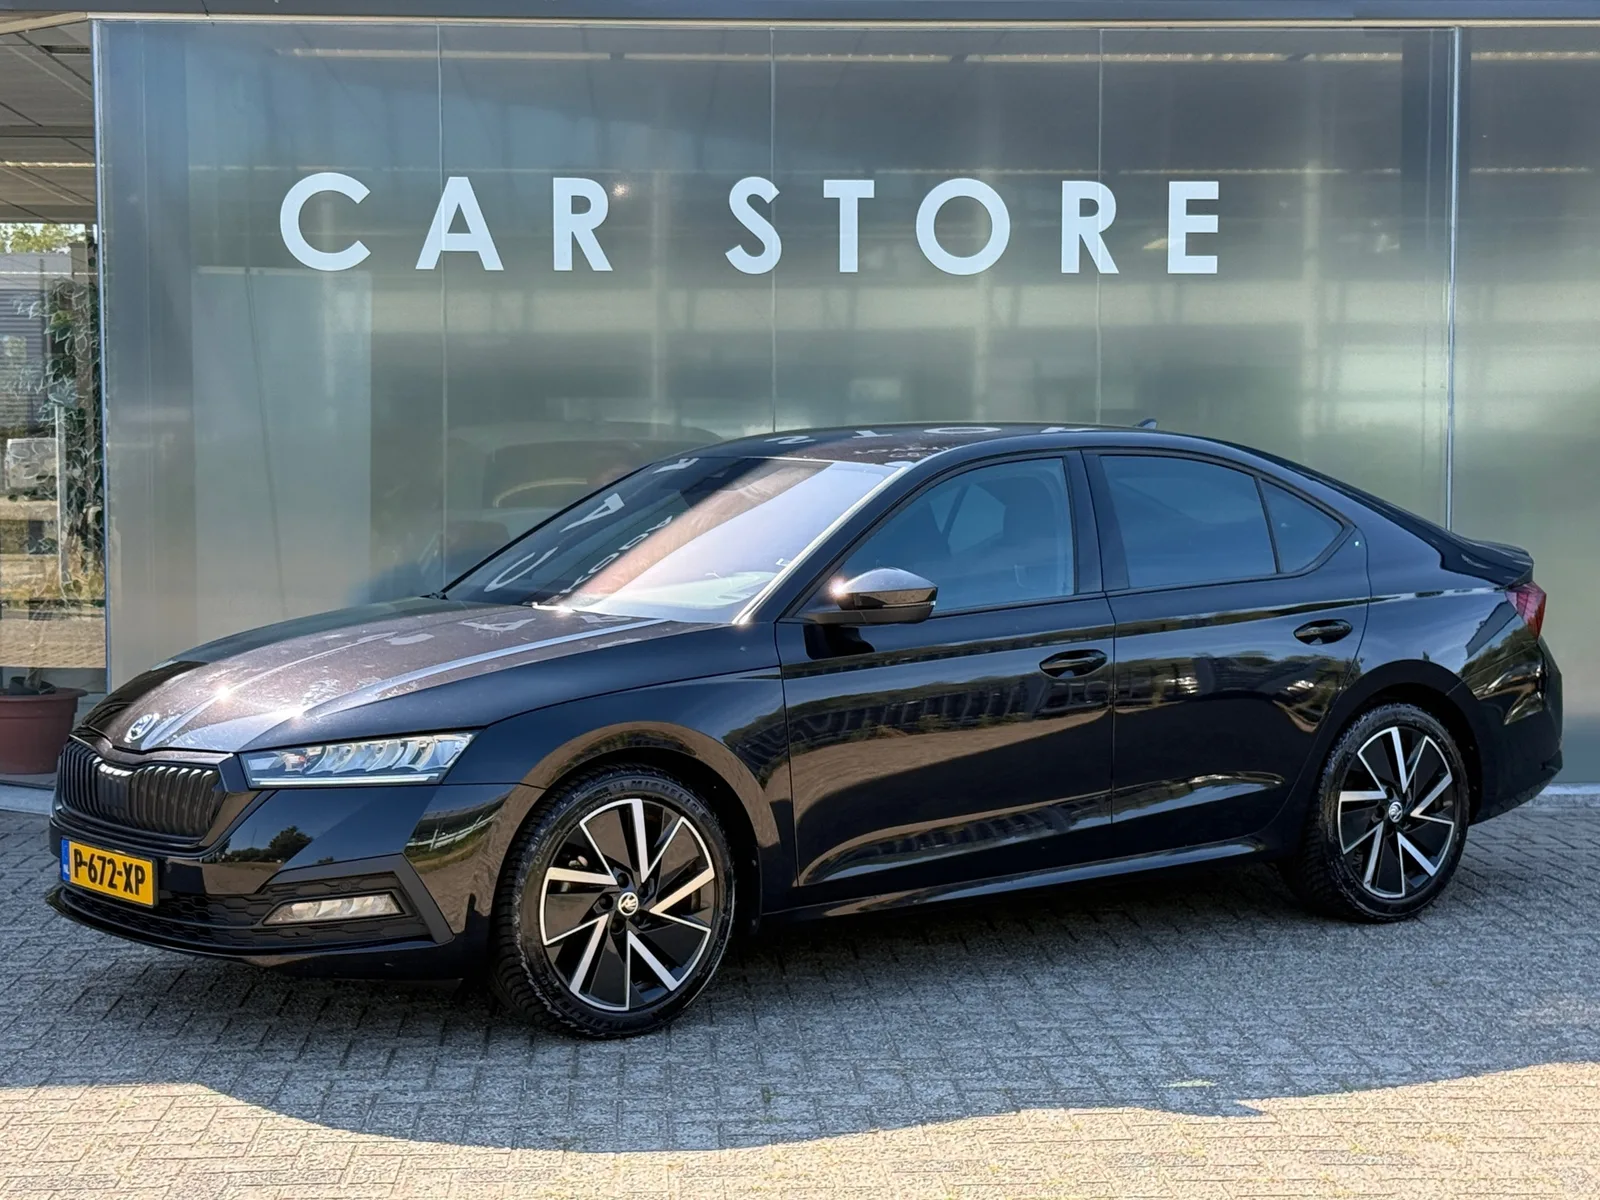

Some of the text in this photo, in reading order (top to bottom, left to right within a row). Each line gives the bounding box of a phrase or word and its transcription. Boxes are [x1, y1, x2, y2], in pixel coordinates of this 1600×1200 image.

[279, 171, 1220, 276] CAR STORE
[73, 848, 146, 896] P-672-XP
